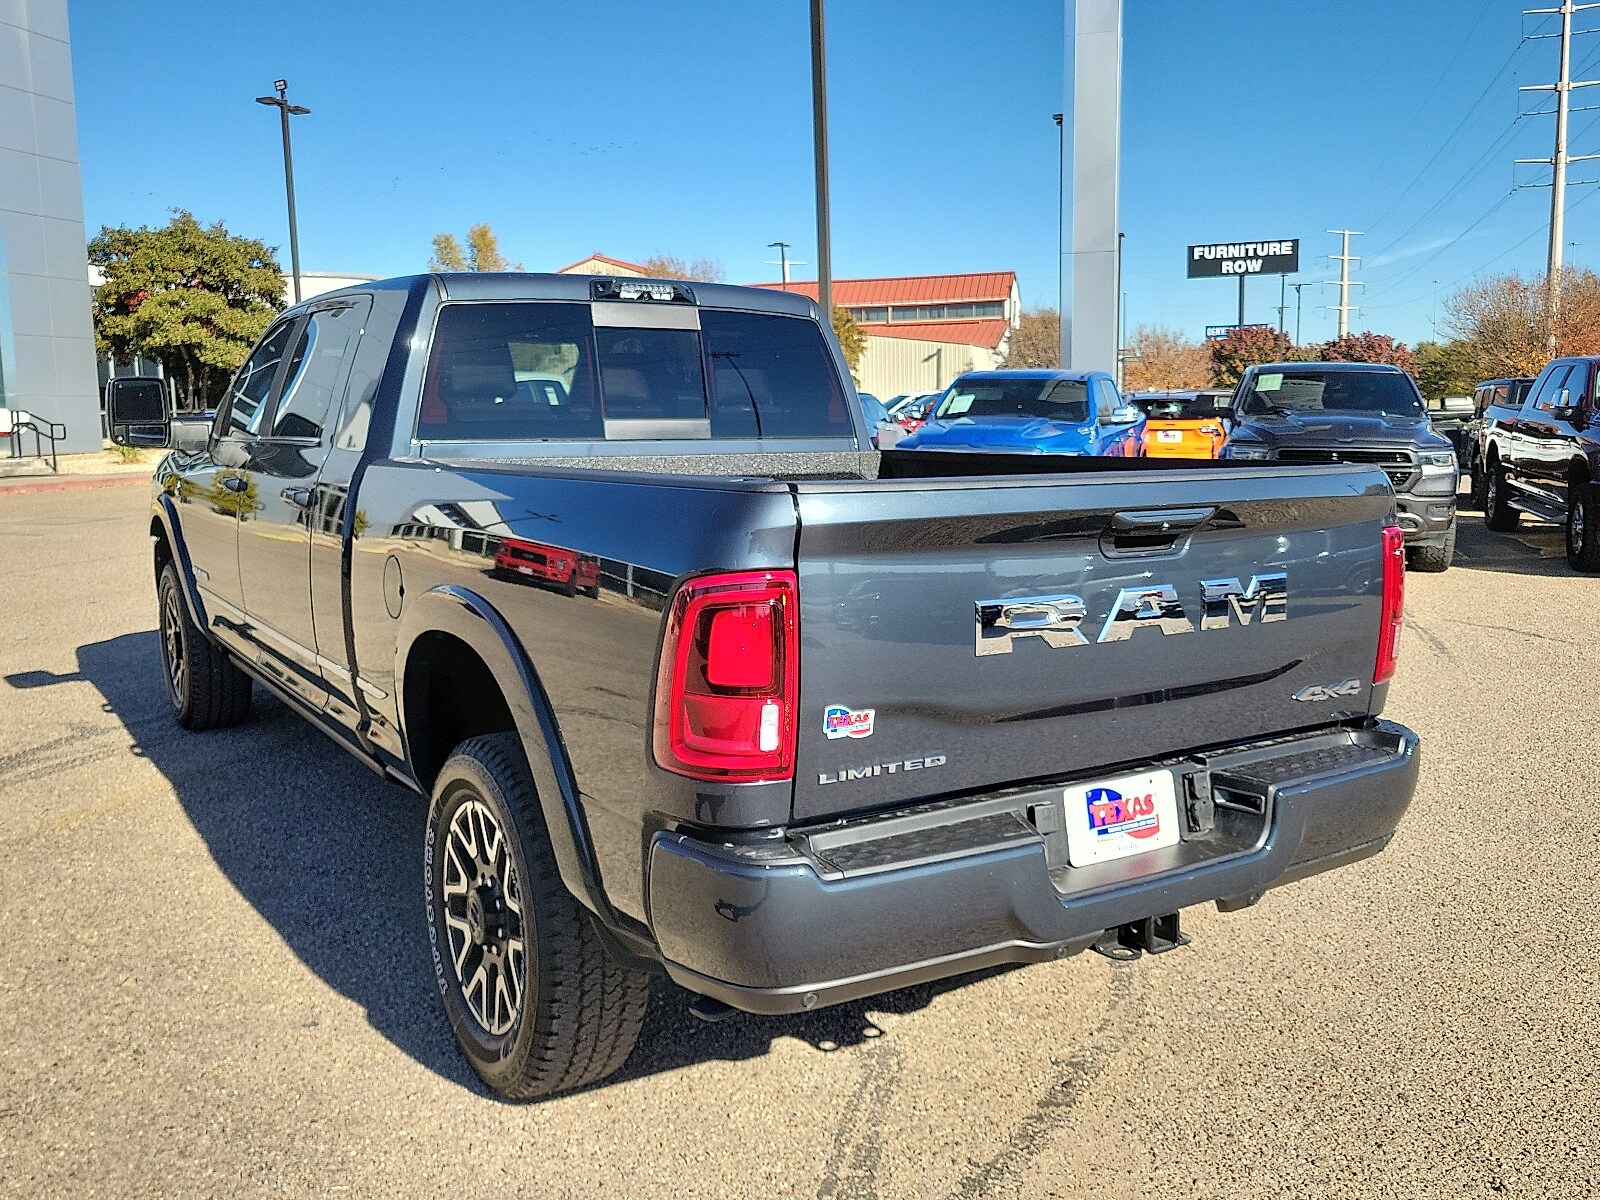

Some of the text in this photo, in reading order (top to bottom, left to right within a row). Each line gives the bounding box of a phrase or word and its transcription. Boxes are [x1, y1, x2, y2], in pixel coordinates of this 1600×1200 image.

[1193, 241, 1293, 260] FURNITURE
[1221, 259, 1263, 274] ROW
[974, 572, 1288, 657] RAM
[828, 712, 870, 728] TEXAS
[817, 755, 947, 785] LIMITED
[1089, 794, 1154, 828] TEXAS
